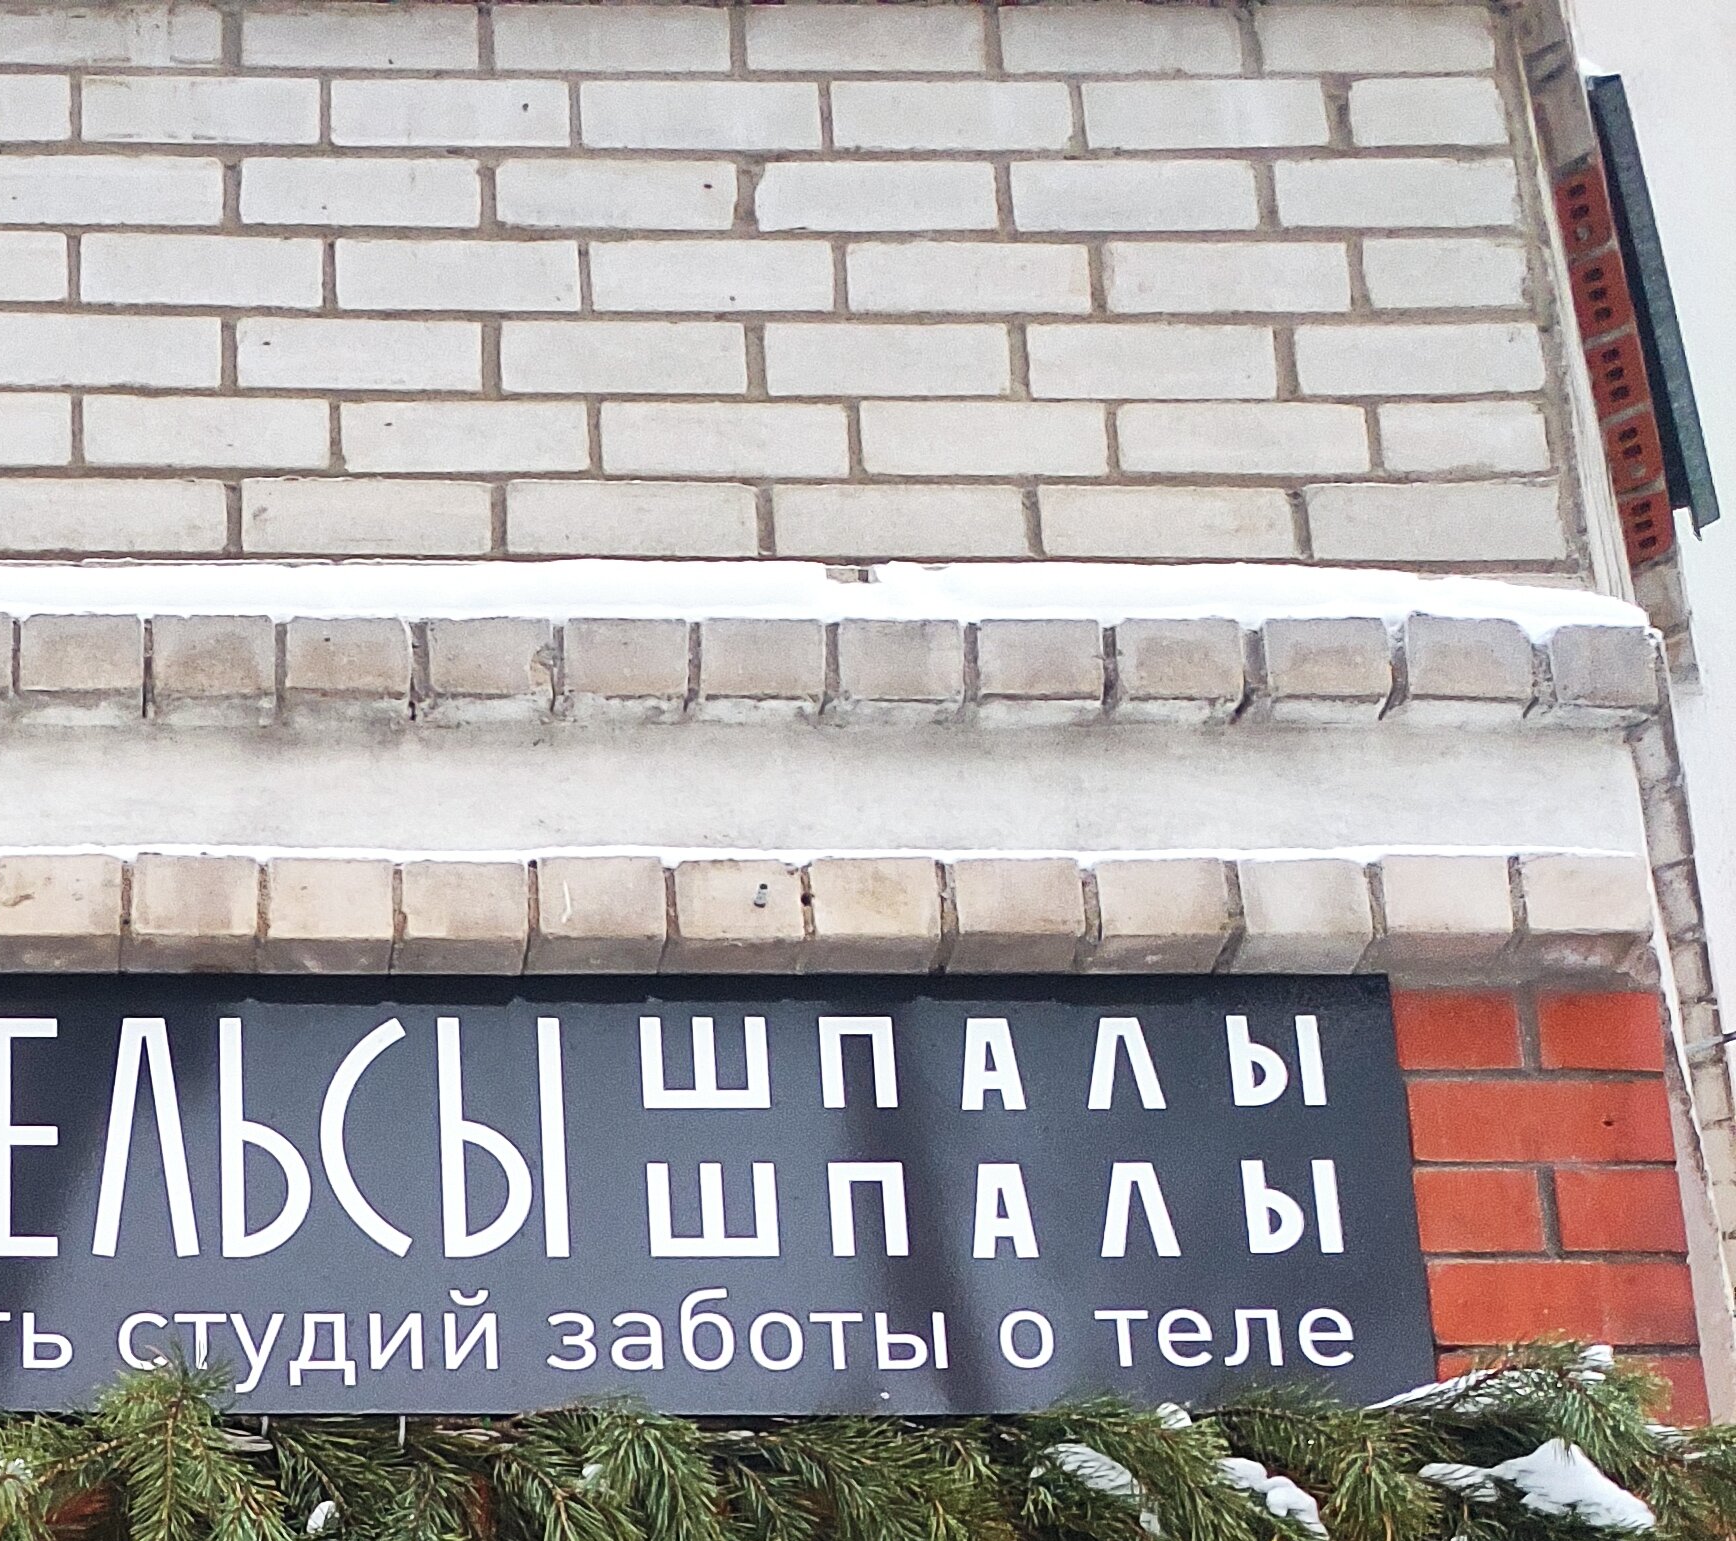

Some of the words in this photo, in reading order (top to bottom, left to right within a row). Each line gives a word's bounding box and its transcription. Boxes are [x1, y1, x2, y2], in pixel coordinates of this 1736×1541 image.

[639, 1014, 1328, 1111] ШПАЛЫ
[646, 1159, 1345, 1259] ШПАЛЫ
[117, 1289, 500, 1392] студий
[546, 1287, 948, 1371] заботы
[999, 1308, 1055, 1370] о
[1094, 1307, 1356, 1369] теле
